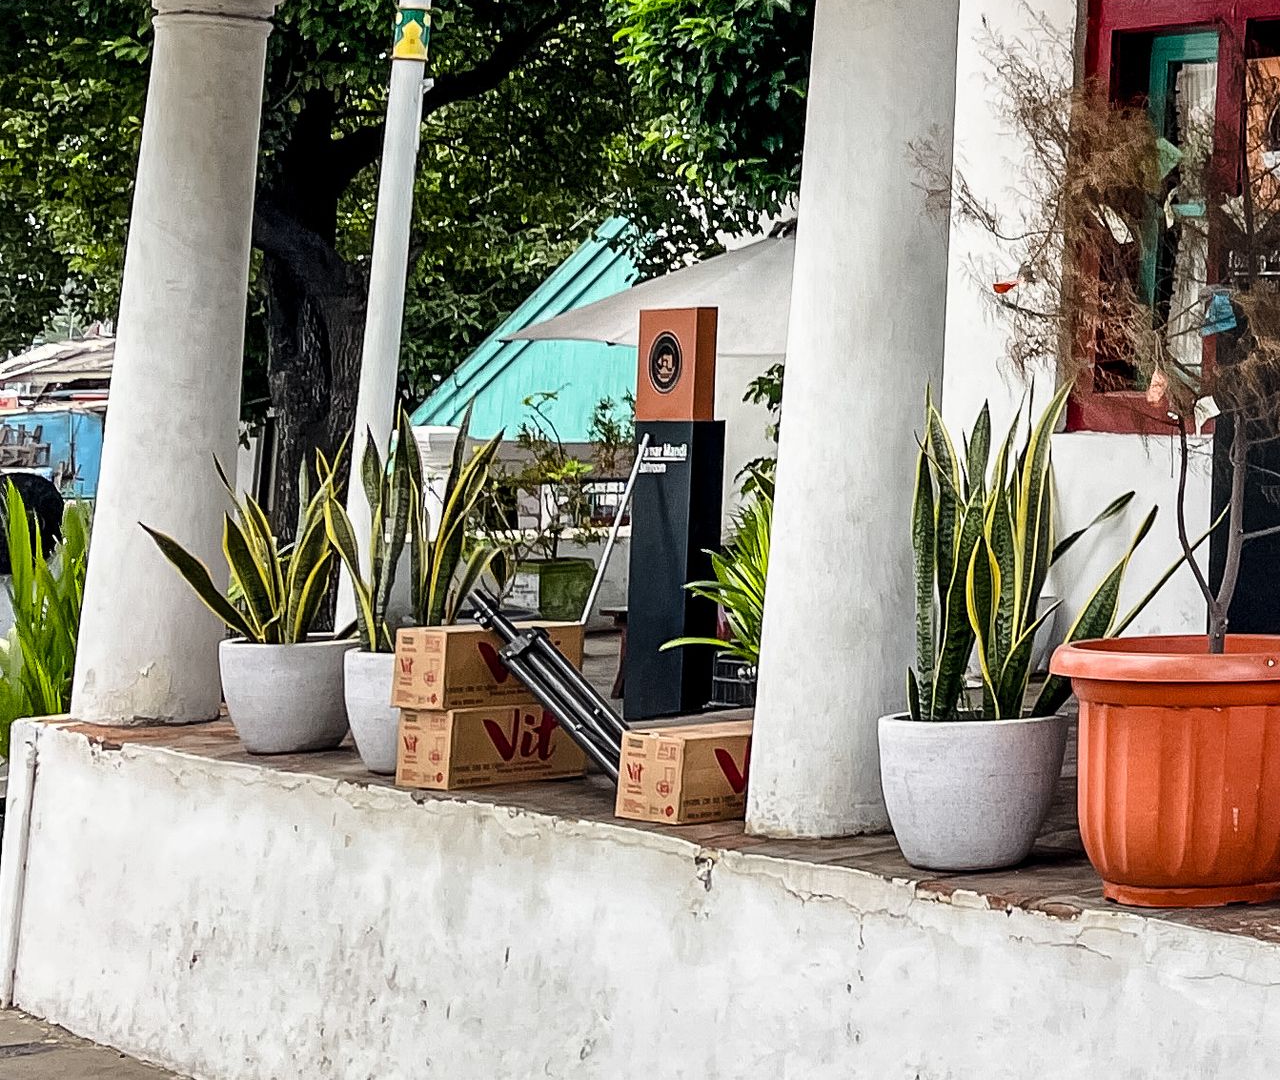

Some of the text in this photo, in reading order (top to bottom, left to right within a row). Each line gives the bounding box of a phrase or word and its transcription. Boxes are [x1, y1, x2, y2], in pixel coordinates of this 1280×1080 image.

[403, 735, 419, 753] Vit
[482, 708, 561, 762] Vit
[626, 761, 644, 783] Vit
